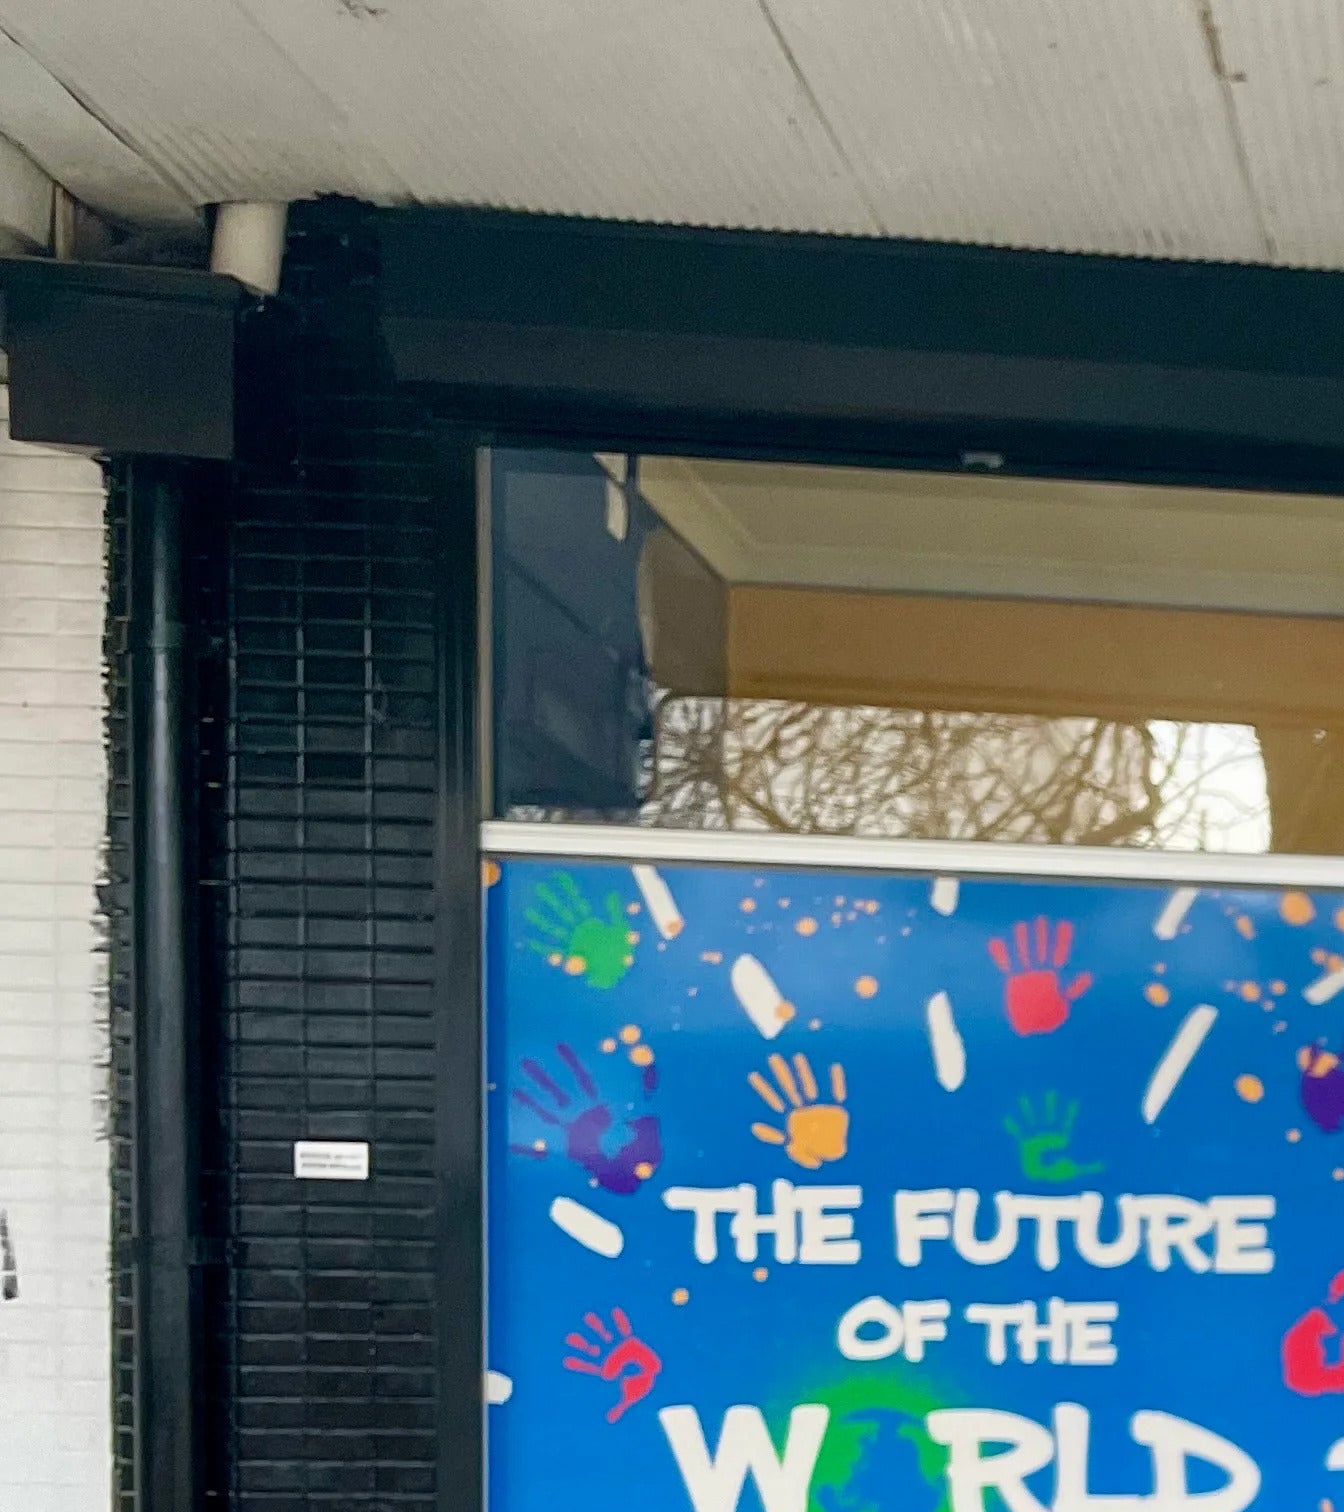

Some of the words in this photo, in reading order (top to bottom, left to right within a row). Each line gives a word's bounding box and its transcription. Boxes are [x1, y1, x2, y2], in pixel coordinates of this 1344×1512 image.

[664, 1180, 862, 1264] THE
[895, 1189, 1275, 1273] FUTURE
[838, 1296, 950, 1362] OF
[965, 1297, 1118, 1365] THE
